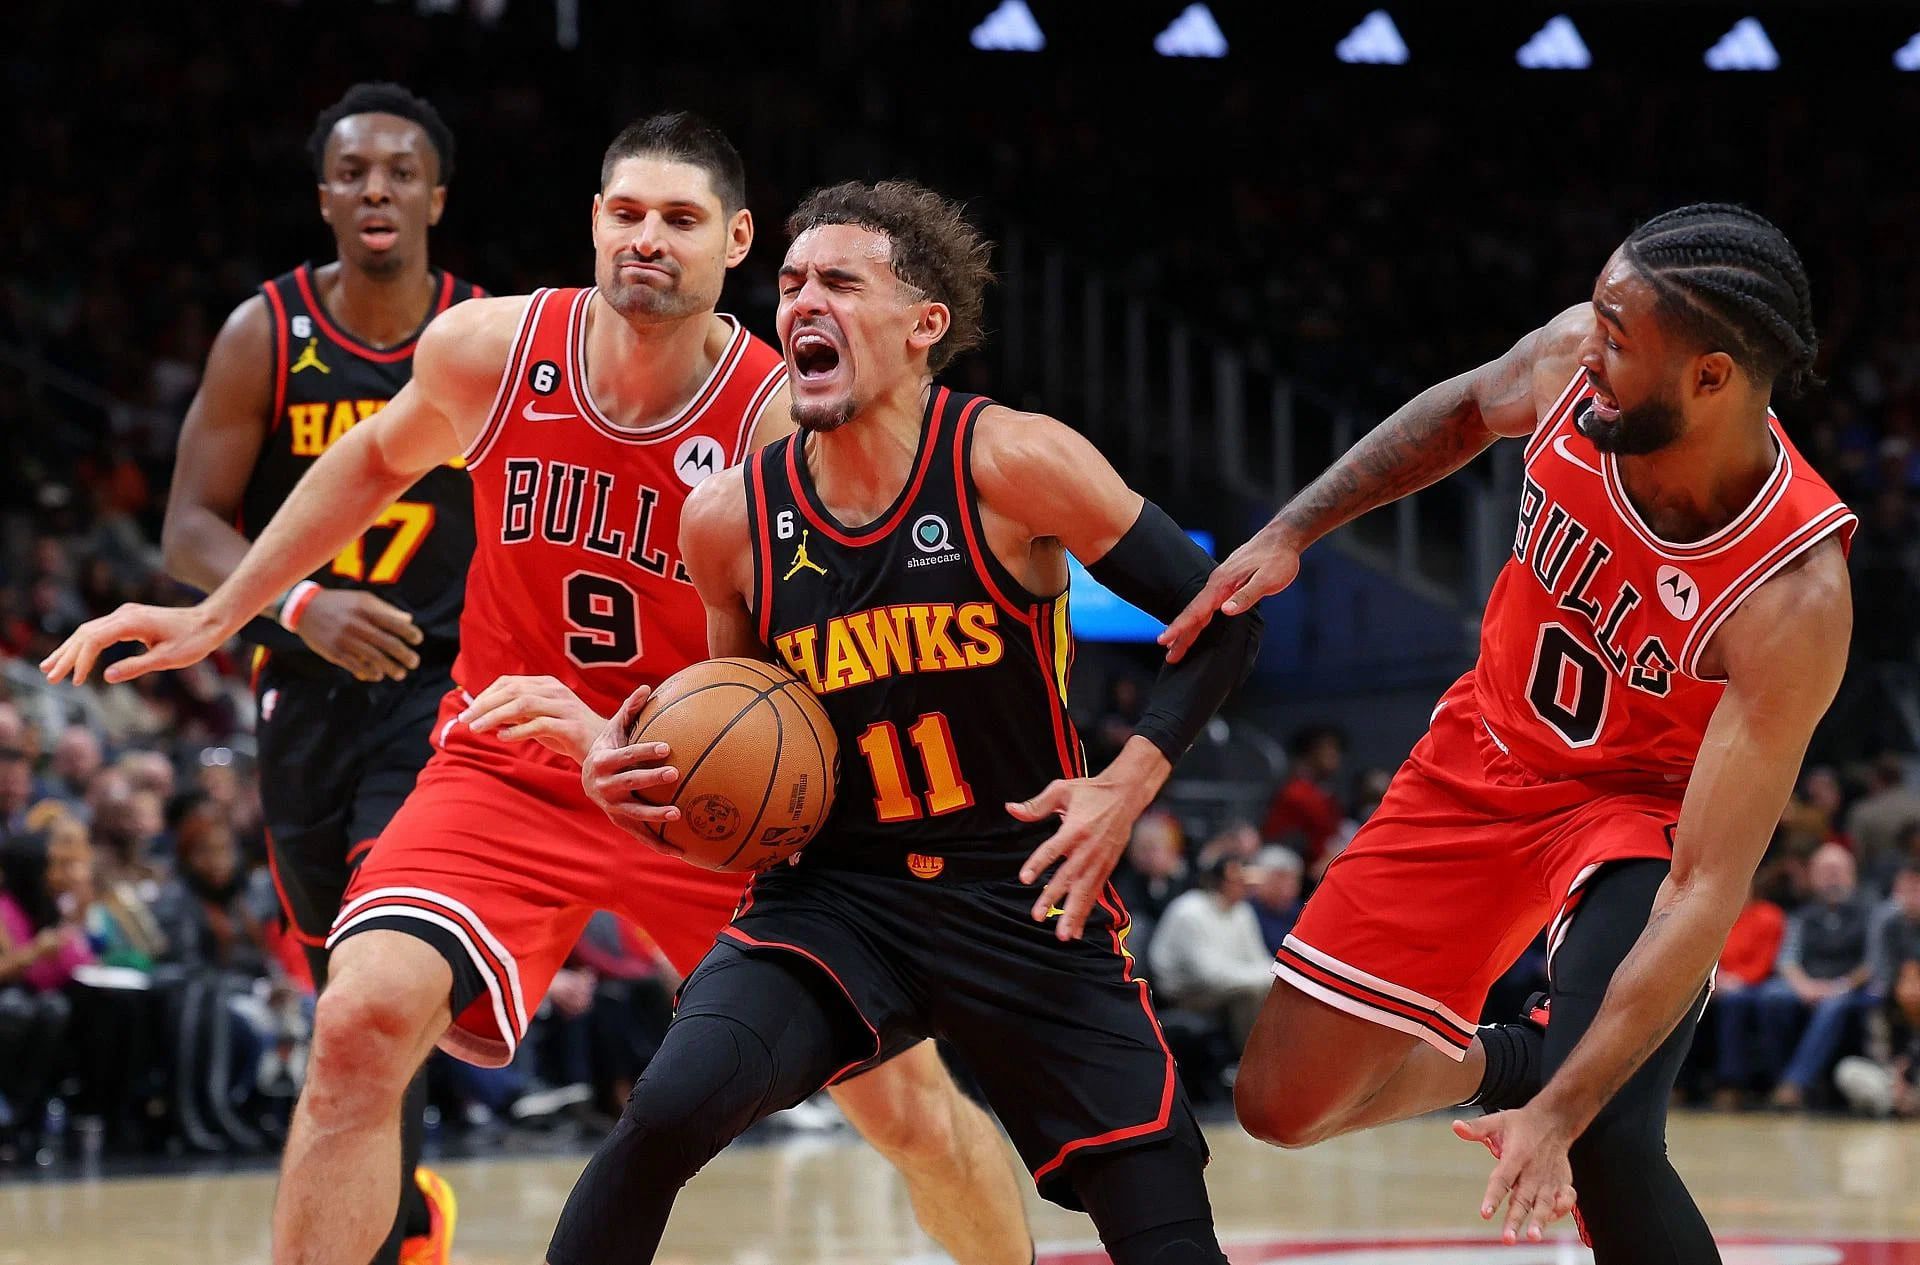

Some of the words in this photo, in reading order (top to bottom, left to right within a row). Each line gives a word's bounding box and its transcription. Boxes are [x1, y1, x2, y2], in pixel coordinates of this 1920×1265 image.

[291, 315, 312, 338] 6
[533, 364, 555, 392] 6
[501, 458, 694, 583] BULL
[777, 510, 794, 540] 6
[907, 552, 961, 569] sharecare
[562, 569, 643, 669] 9
[1513, 466, 1679, 699] BULLS
[774, 602, 1004, 694] HAWKS
[1525, 622, 1612, 749] 0
[856, 711, 976, 823] 11
[911, 854, 939, 869] ATL
